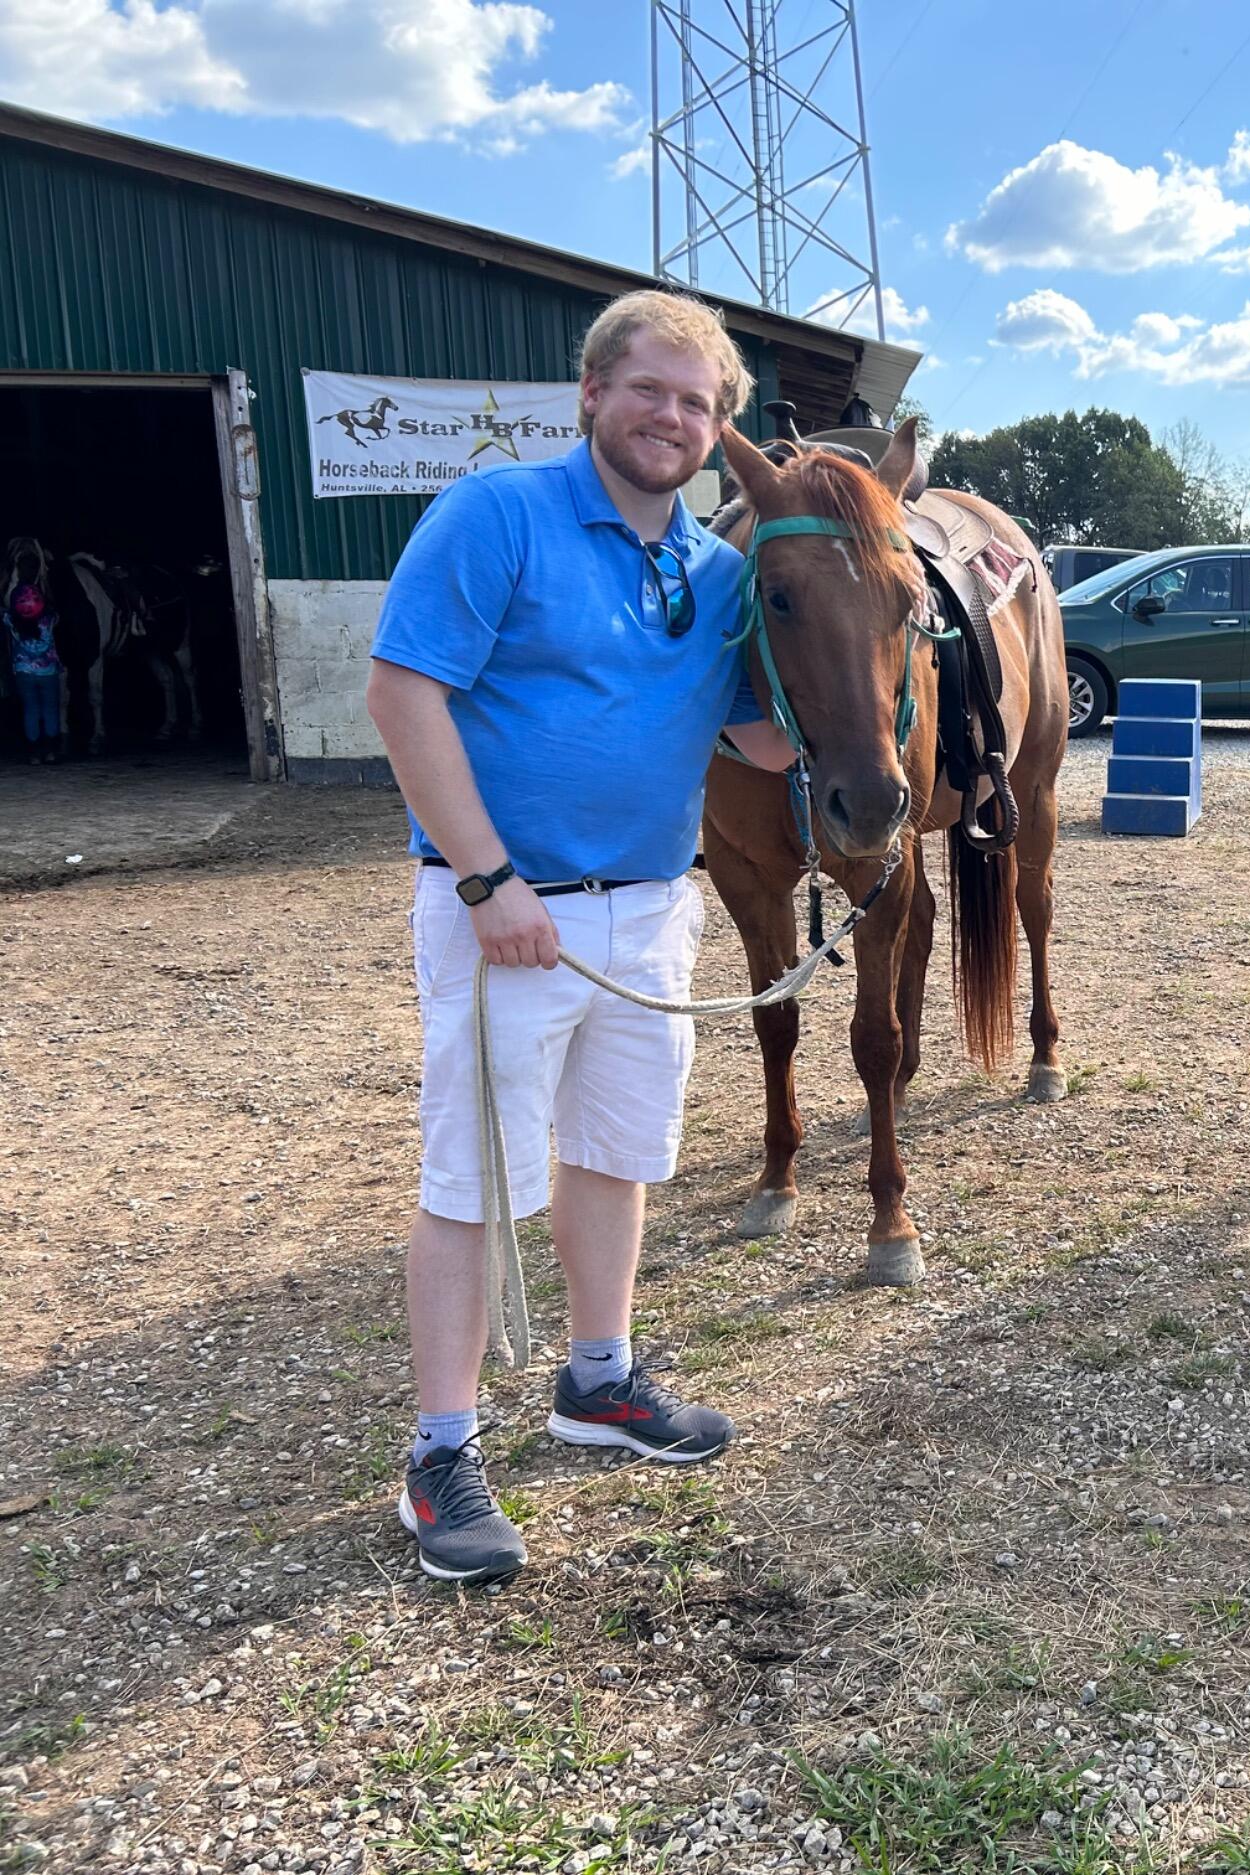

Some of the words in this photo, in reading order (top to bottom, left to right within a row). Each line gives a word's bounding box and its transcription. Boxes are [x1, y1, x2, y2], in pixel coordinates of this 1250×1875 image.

[398, 418, 464, 436] Star
[319, 459, 410, 479] Horseback
[320, 483, 387, 493] Huntsville,
[391, 484, 407, 493] AL
